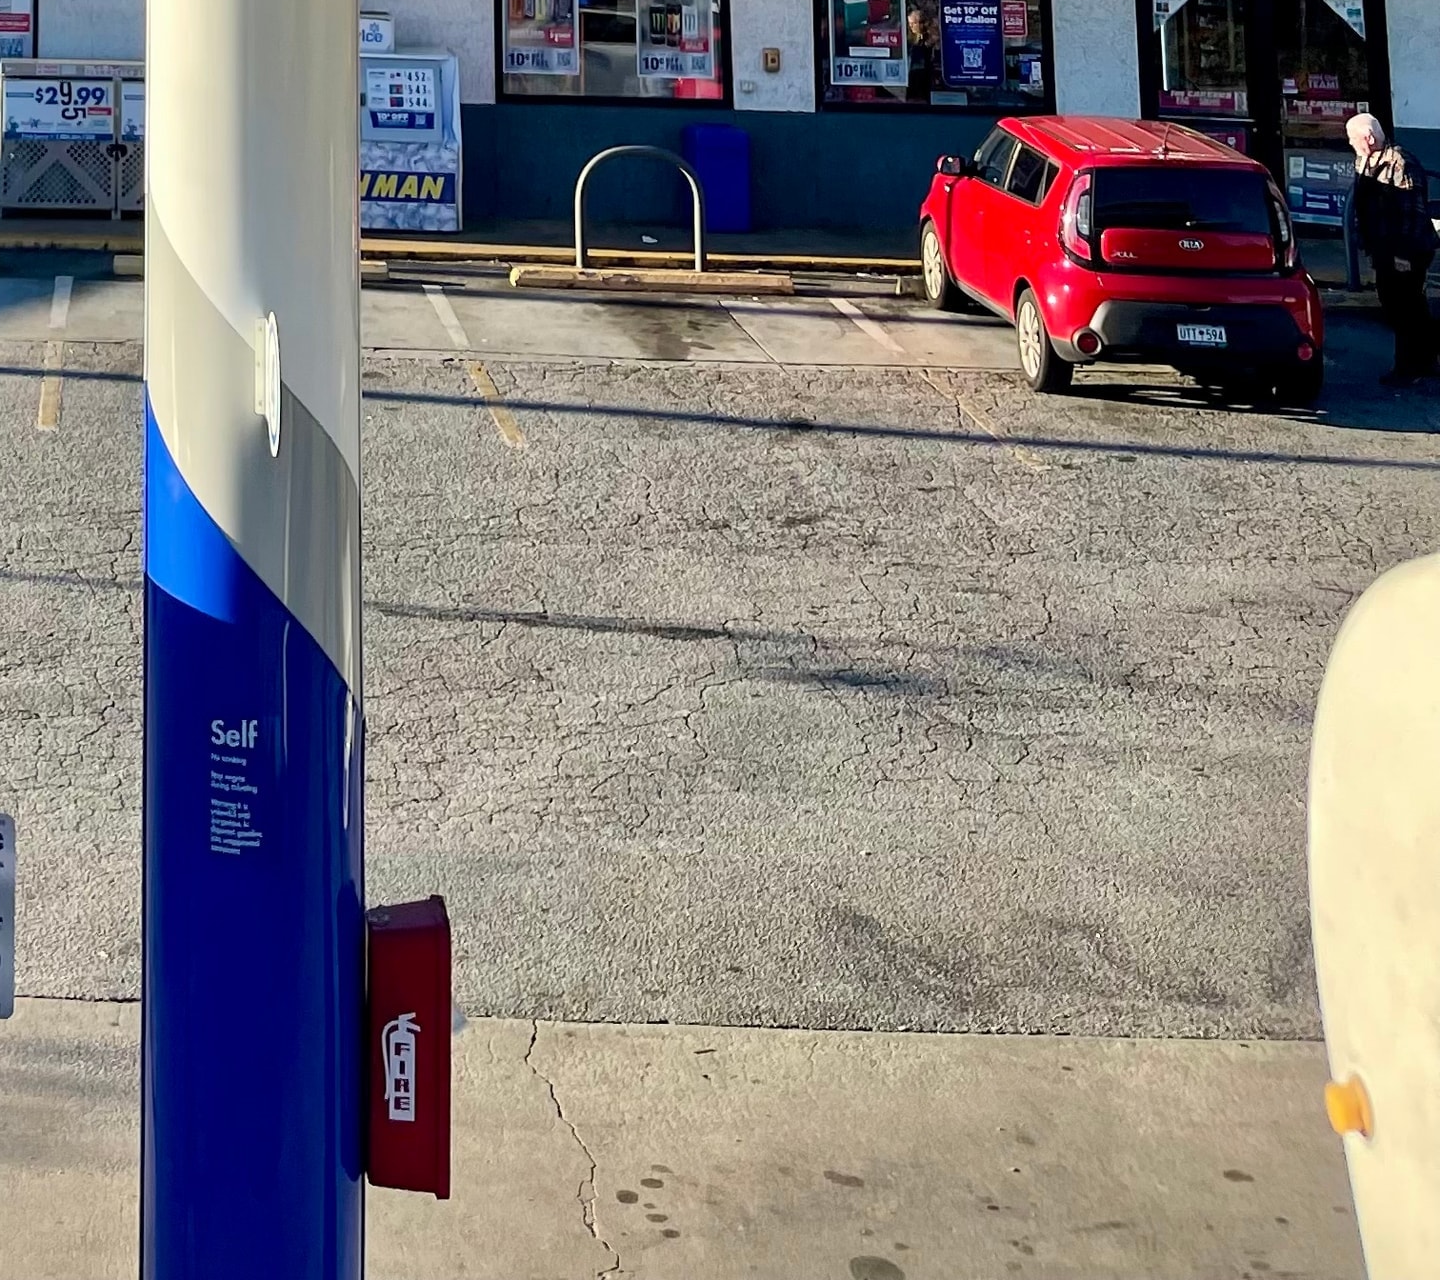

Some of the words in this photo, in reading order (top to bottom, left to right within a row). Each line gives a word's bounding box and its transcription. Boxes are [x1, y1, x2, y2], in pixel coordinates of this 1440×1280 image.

[944, 6, 962, 15] Get
[981, 6, 998, 15] Off
[945, 15, 963, 24] Per
[964, 15, 998, 25] Gallon
[1183, 240, 1200, 248] KIA
[1180, 327, 1196, 340] UTT
[211, 720, 258, 748] Self
[394, 1042, 410, 1111] FIRE
